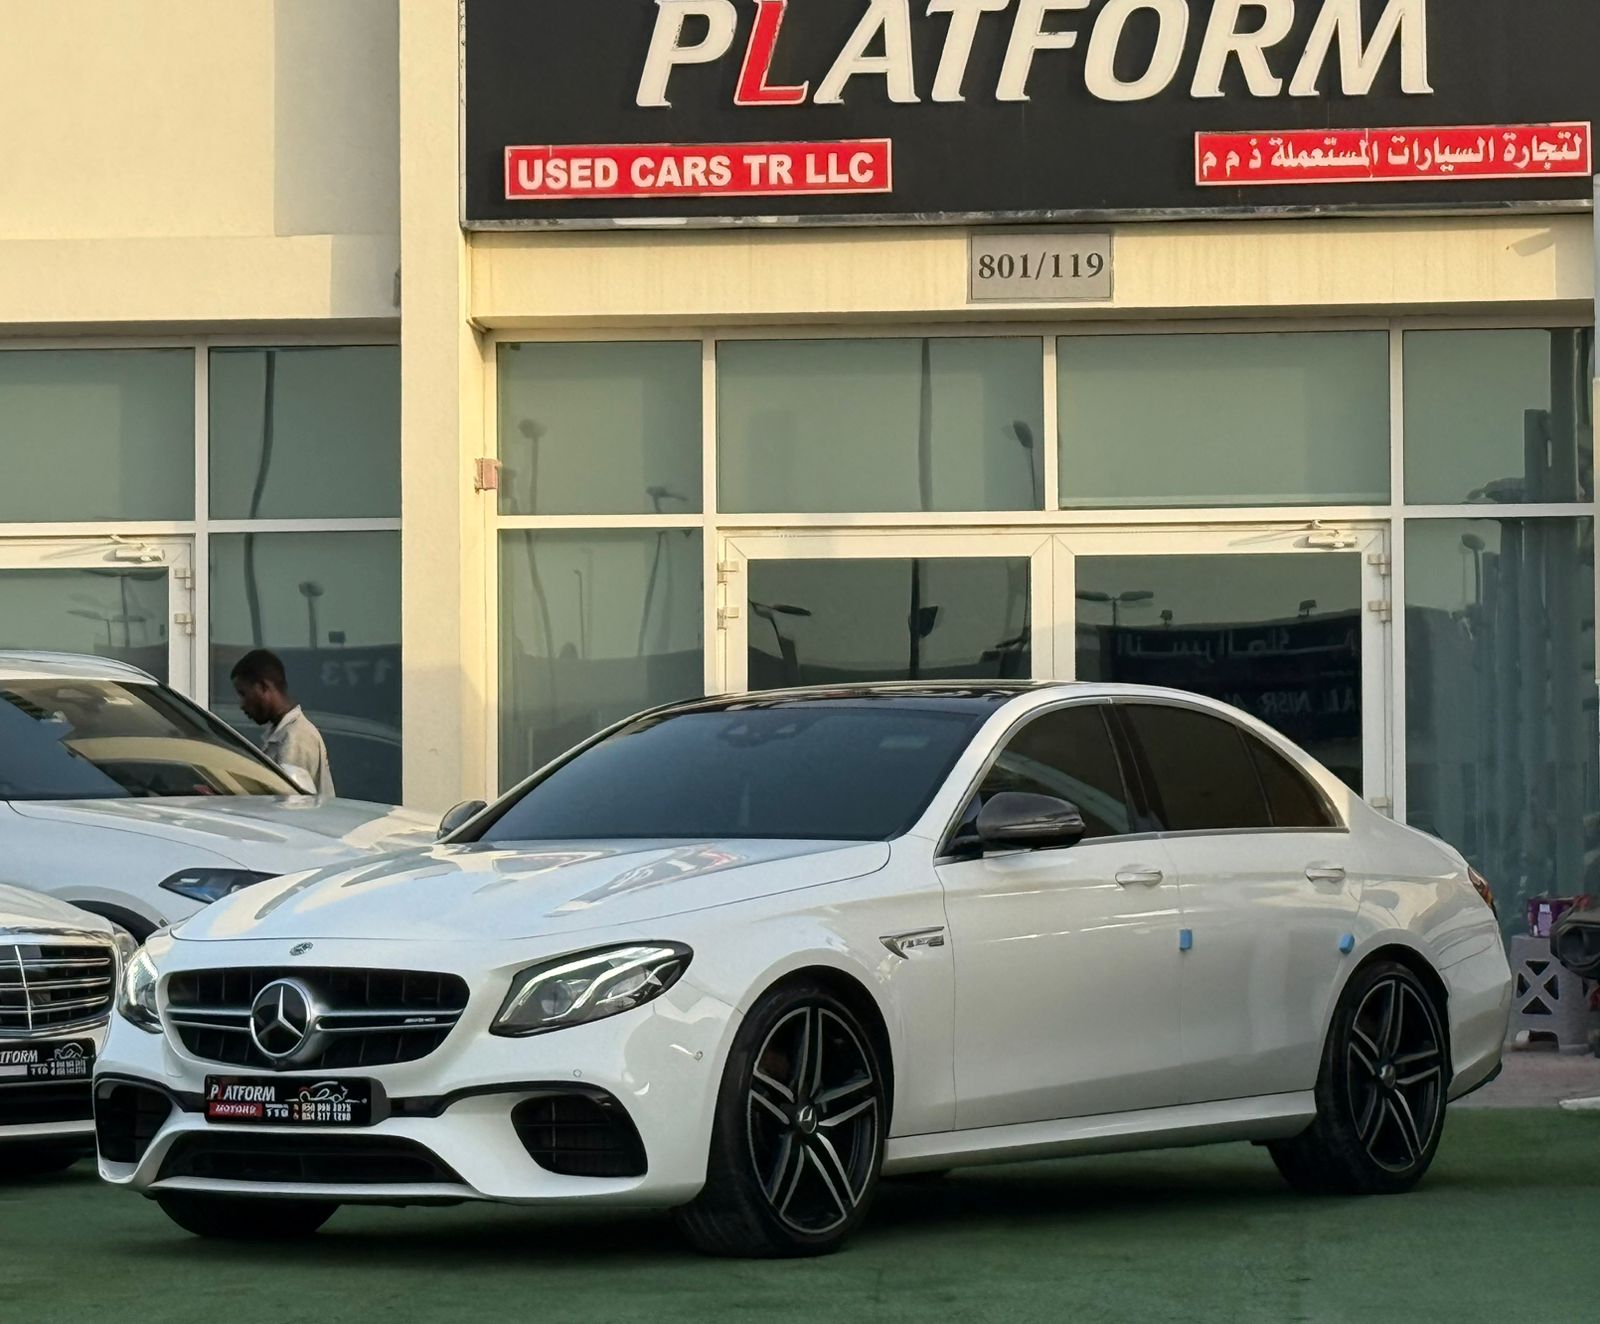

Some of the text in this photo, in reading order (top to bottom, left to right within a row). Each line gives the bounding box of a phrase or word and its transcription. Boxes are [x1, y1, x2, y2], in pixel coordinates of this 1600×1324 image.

[636, 0, 1434, 107] PLATFORM
[518, 152, 874, 190] USED CARS TR LLC
[1202, 131, 1582, 177] لتجارة السيارات المستعملة ذ م م
[978, 251, 1104, 280] 801/119
[210, 1084, 275, 1101] PLATFORM
